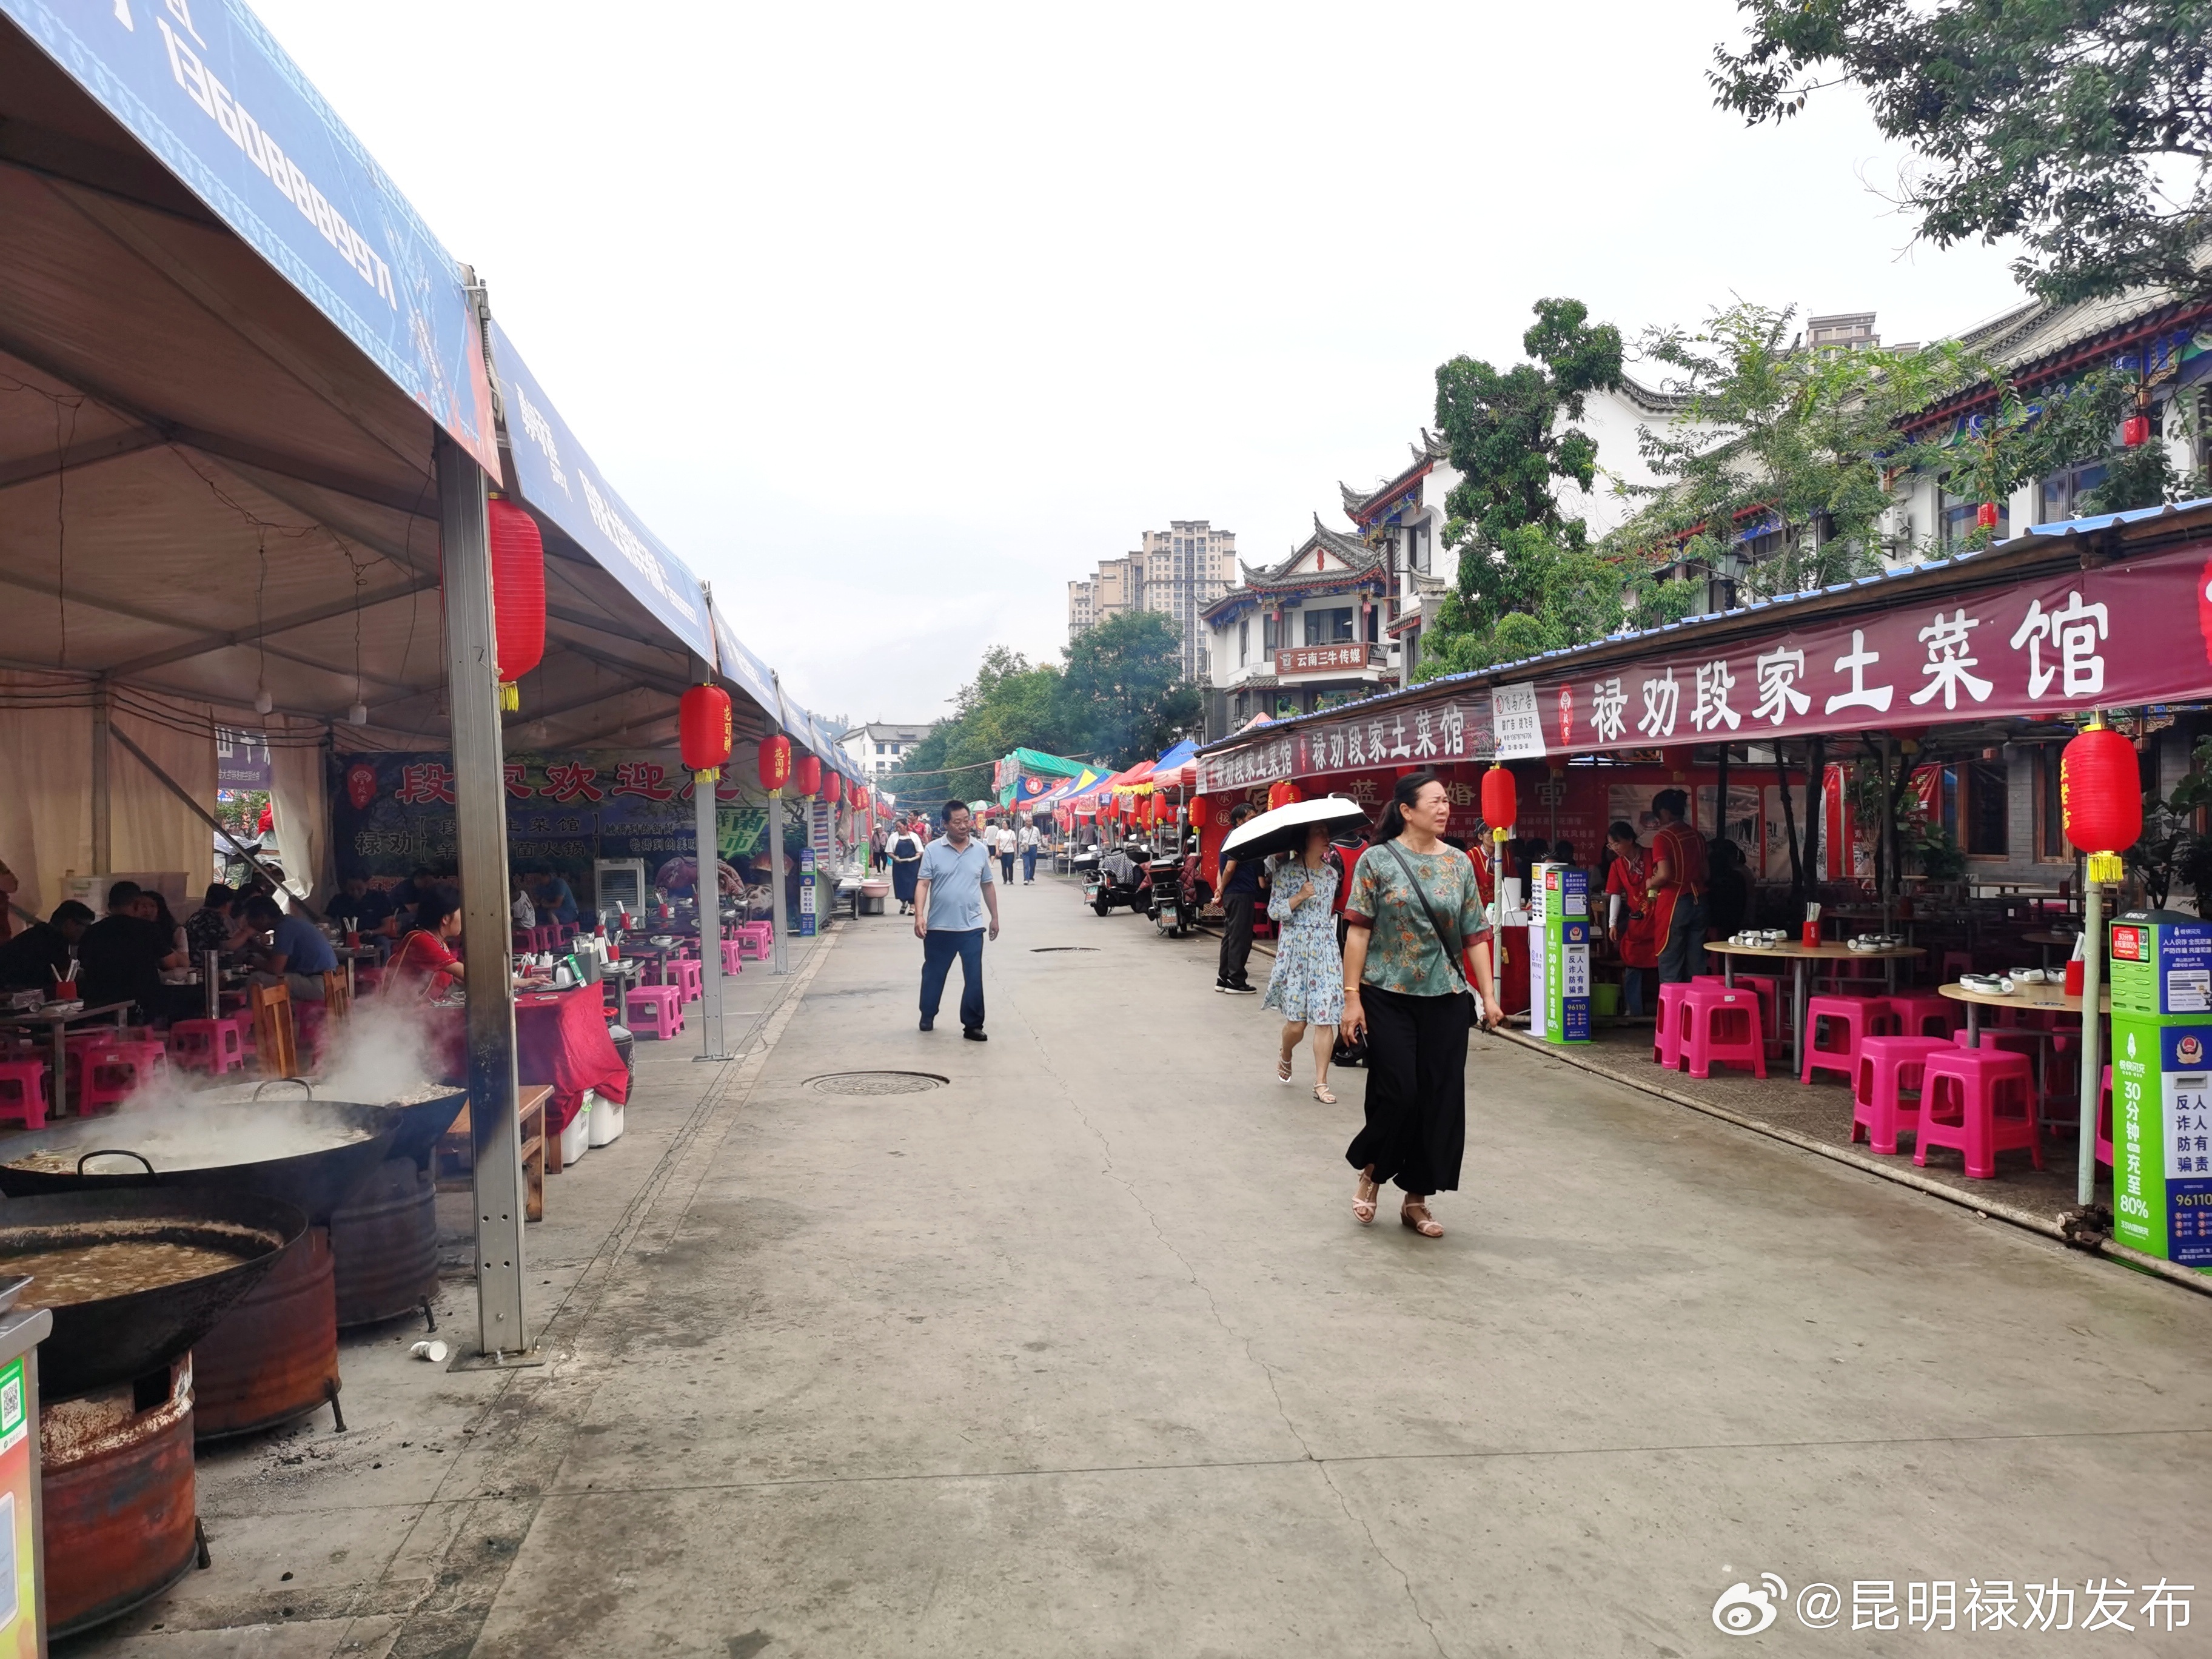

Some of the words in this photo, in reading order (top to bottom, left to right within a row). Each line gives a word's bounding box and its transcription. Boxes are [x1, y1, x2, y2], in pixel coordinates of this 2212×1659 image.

[156, 16, 397, 310] 13608889971
[1296, 648, 1361, 667] 云南三牛传媒
[1590, 590, 2109, 743] 禄劝段家土菜馆
[1216, 739, 1292, 787] 禄劝段家土菜馆
[1312, 705, 1464, 771] 禄劝段家土菜馆
[355, 831, 414, 856] 禄劝
[2176, 1094, 2192, 1172] 反诈防骗
[2193, 1094, 2209, 1172] 人人有责
[2176, 1193, 2212, 1206] 96110
